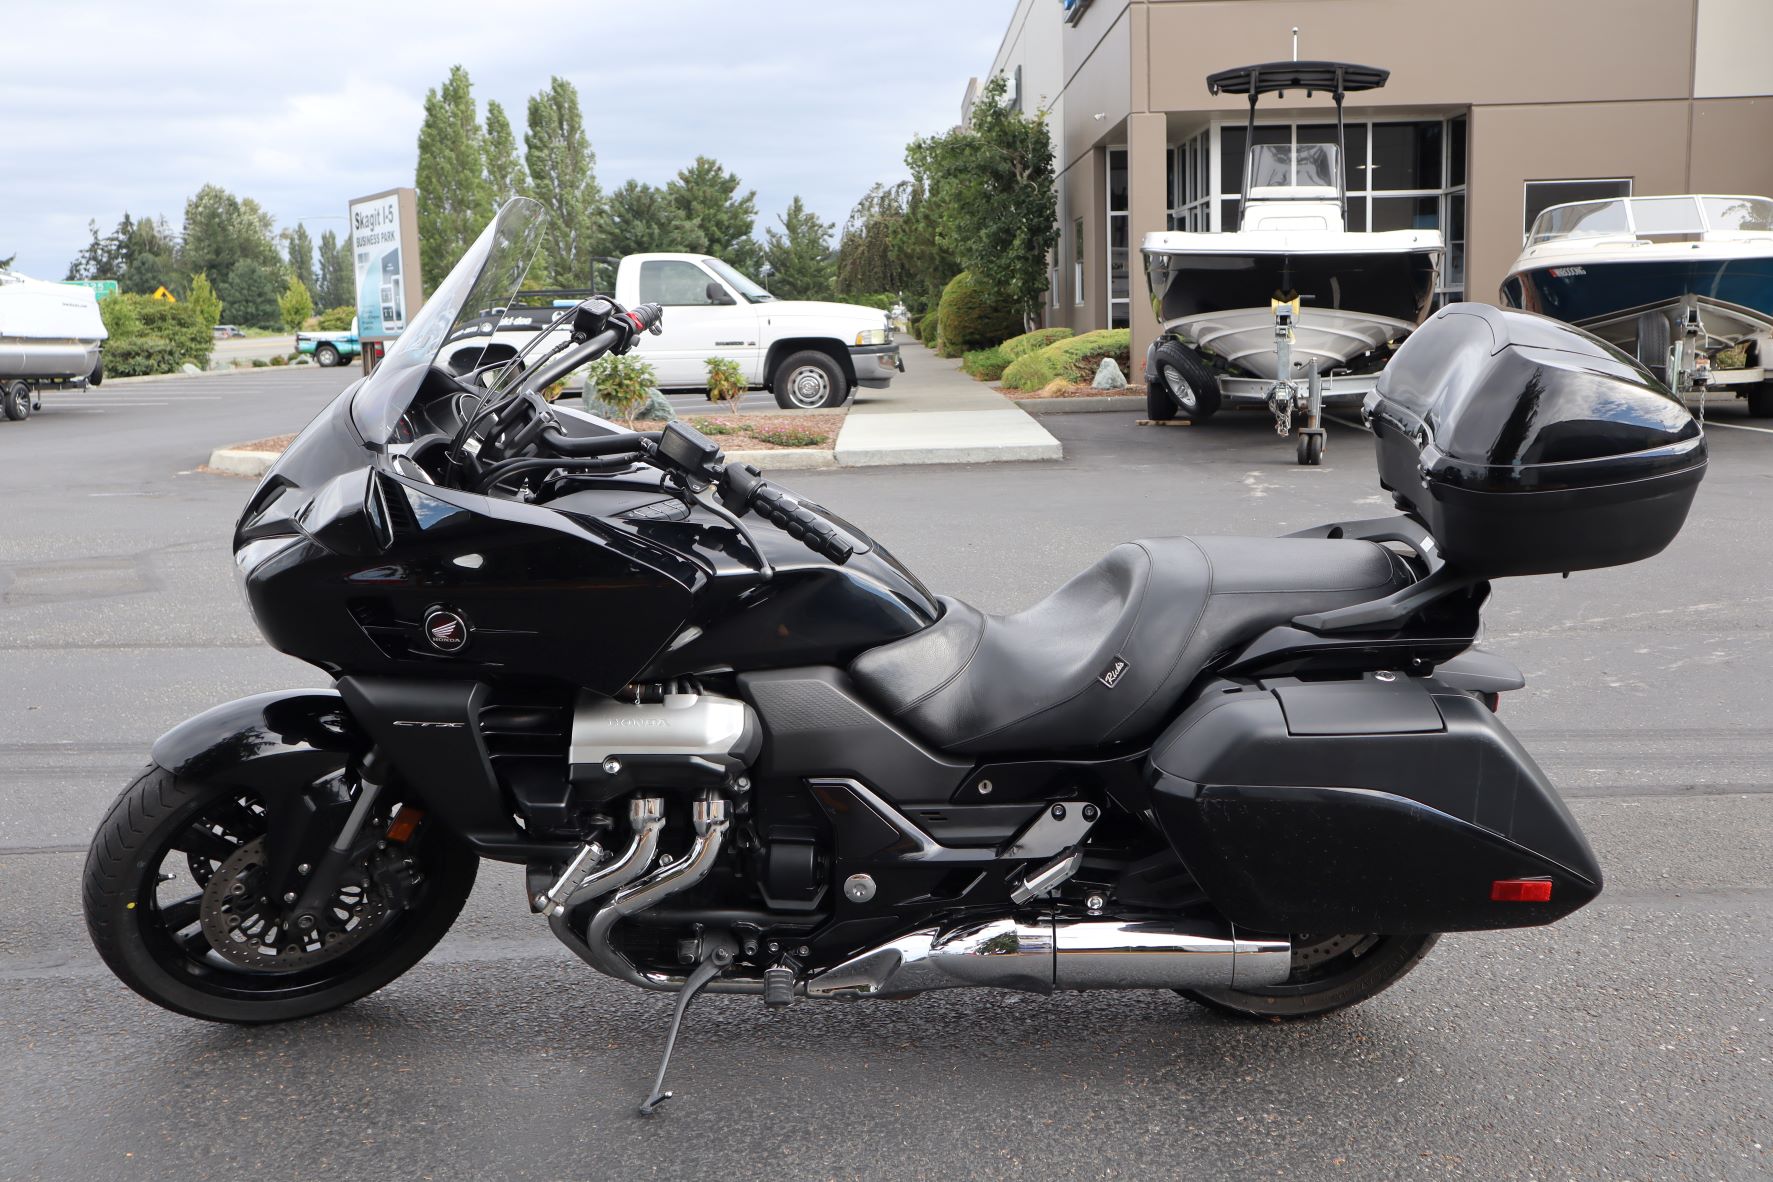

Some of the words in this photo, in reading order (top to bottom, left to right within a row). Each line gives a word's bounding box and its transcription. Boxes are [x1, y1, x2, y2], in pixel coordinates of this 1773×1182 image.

[355, 208, 380, 232] Skagit
[382, 204, 394, 224] I-5
[356, 233, 380, 248] BUSINESS
[381, 231, 396, 243] PARK
